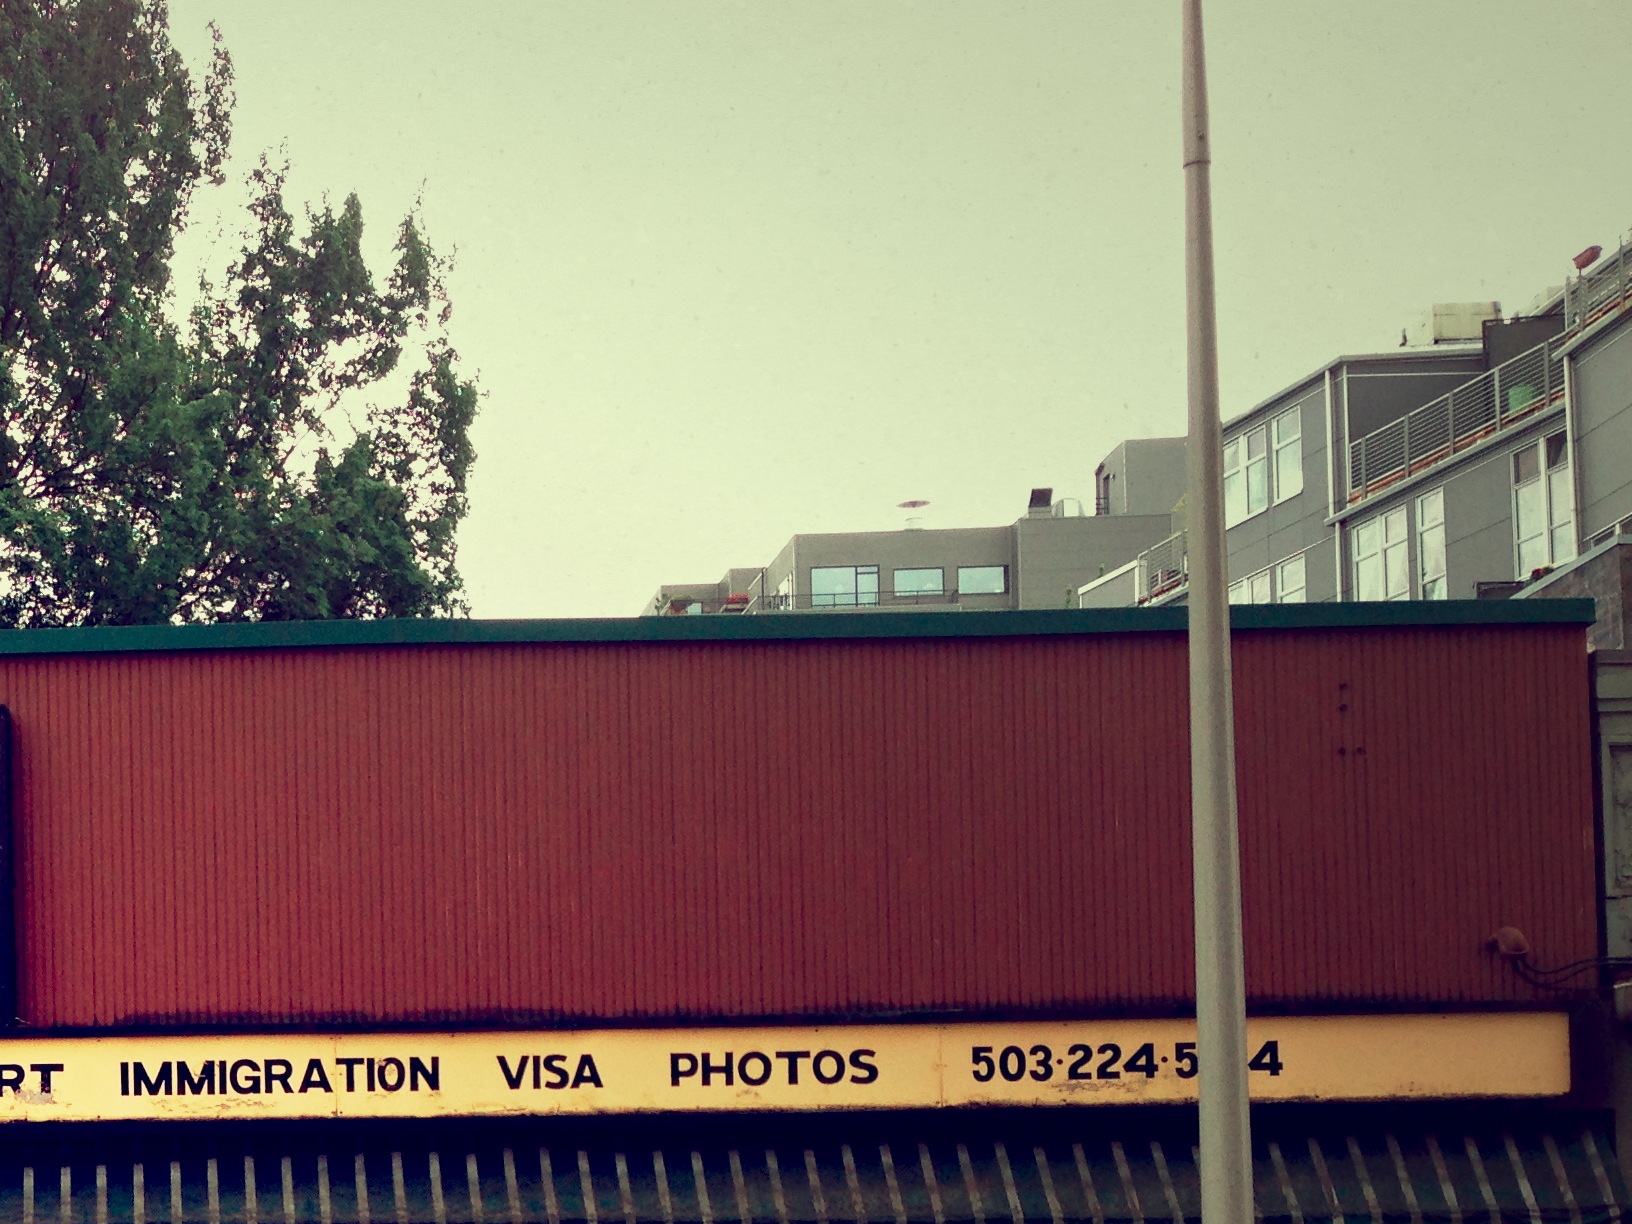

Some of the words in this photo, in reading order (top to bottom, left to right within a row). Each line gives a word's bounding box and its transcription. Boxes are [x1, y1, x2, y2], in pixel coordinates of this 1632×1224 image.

[119, 1056, 441, 1097] IMMIGRATION
[496, 1053, 605, 1091] VISA
[669, 1048, 880, 1088] PHOTOS
